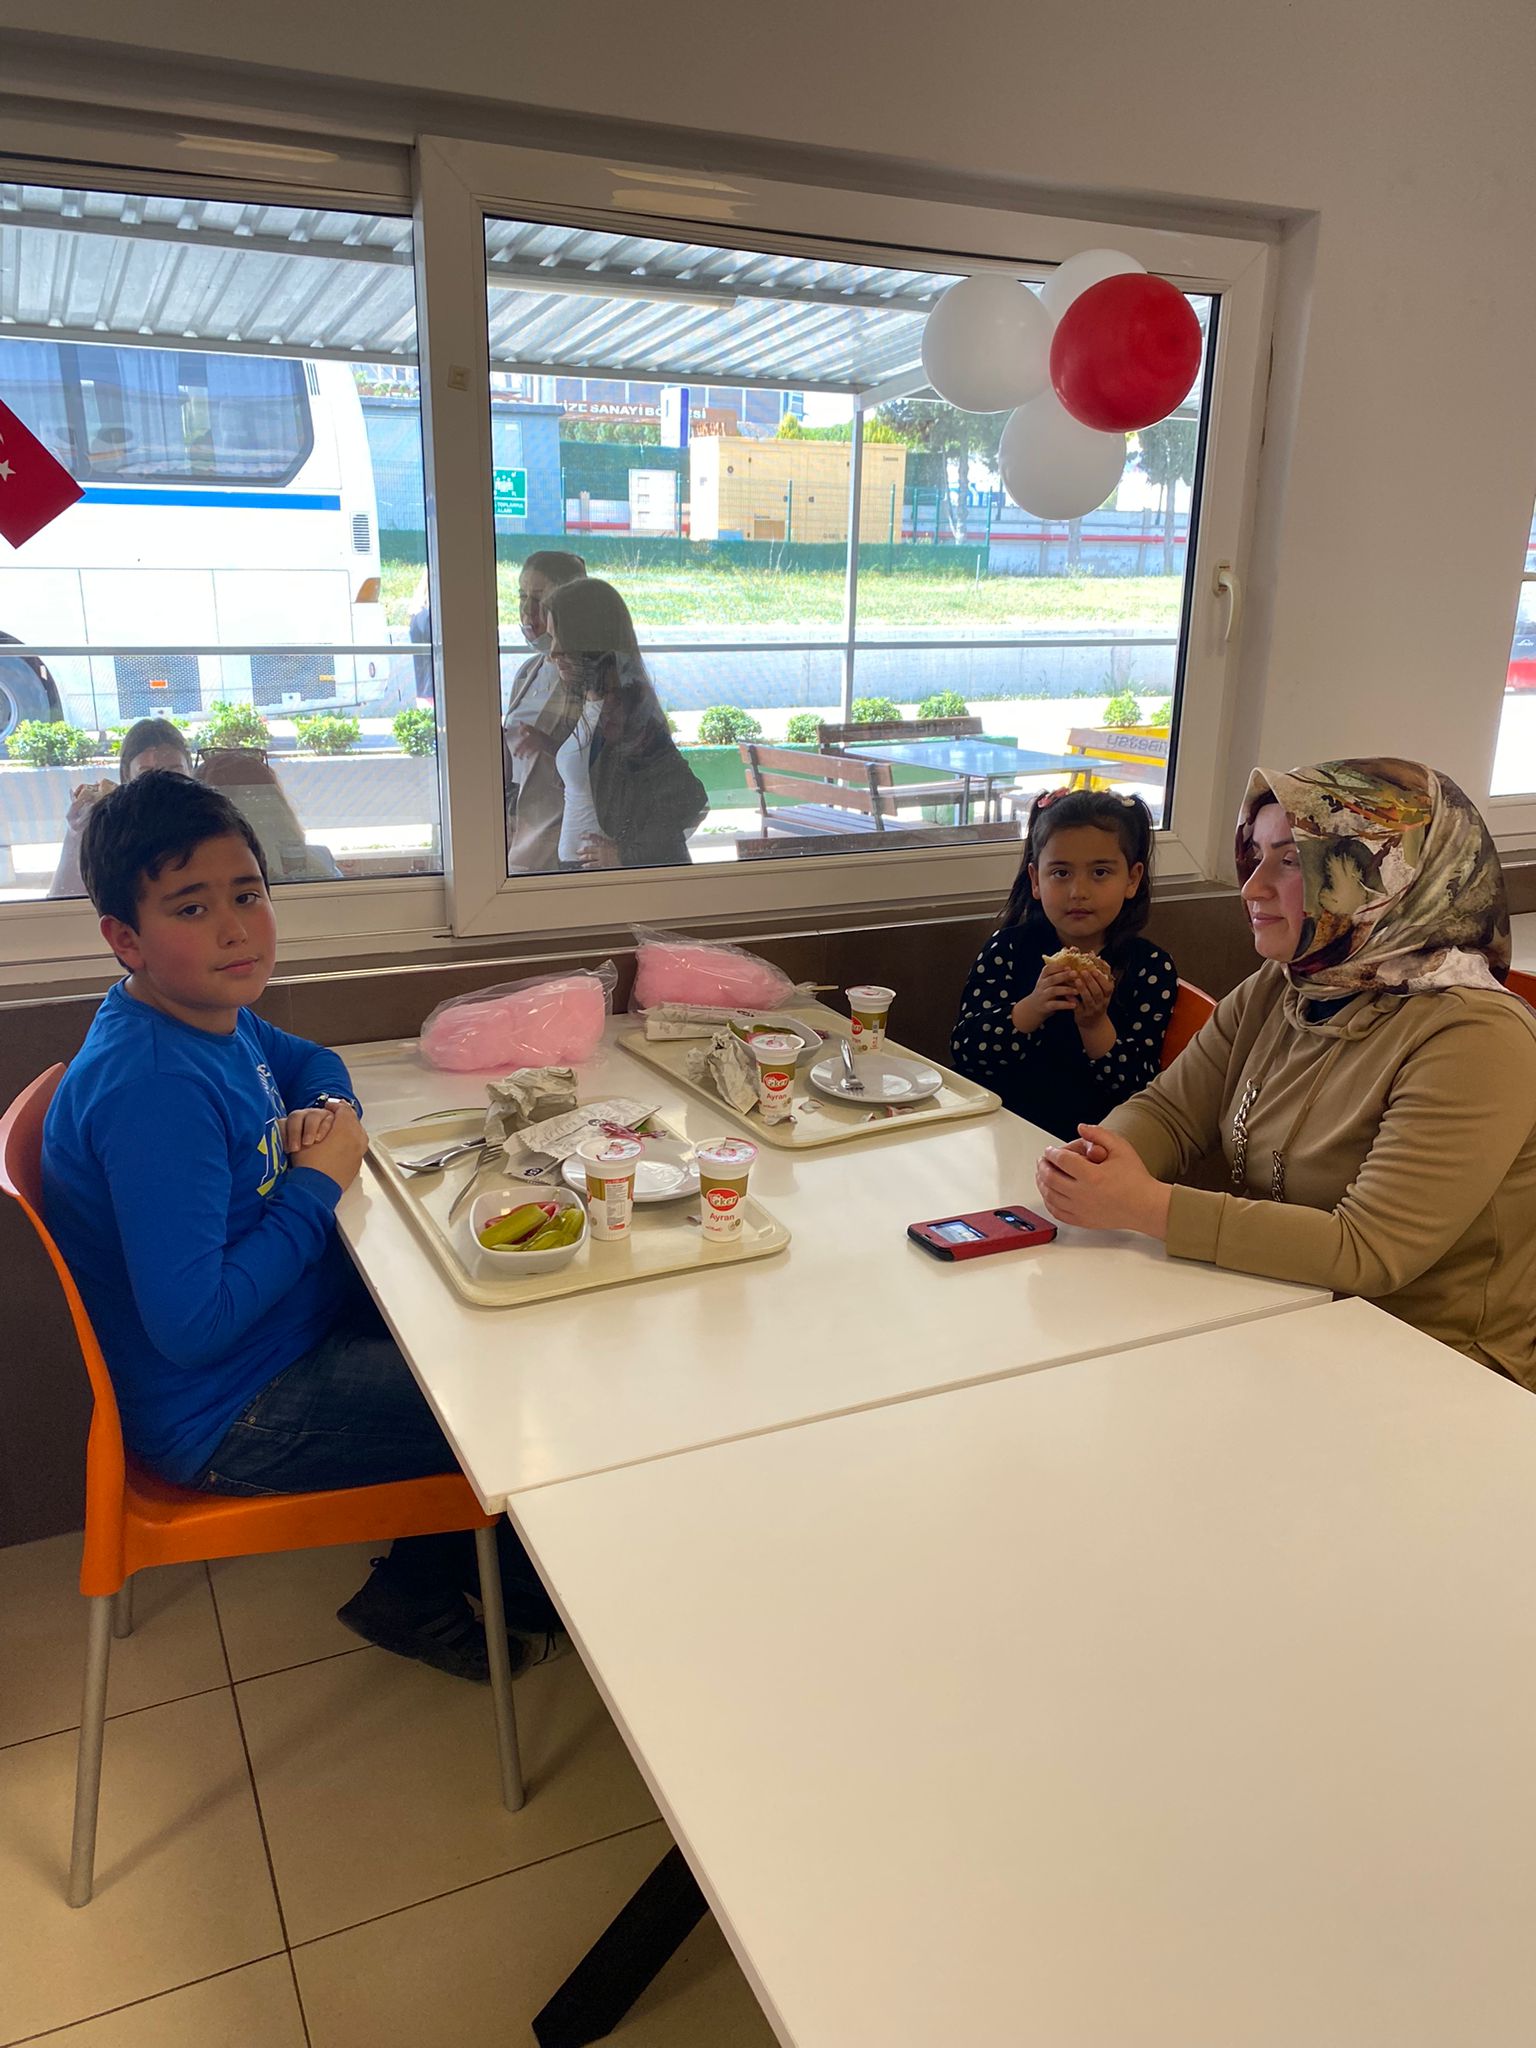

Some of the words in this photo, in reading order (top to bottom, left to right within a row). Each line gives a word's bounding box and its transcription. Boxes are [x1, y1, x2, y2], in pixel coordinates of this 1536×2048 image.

[590, 403, 643, 416] SANAYİ
[766, 1093, 787, 1101] Ayran
[709, 1213, 735, 1222] Ayran
